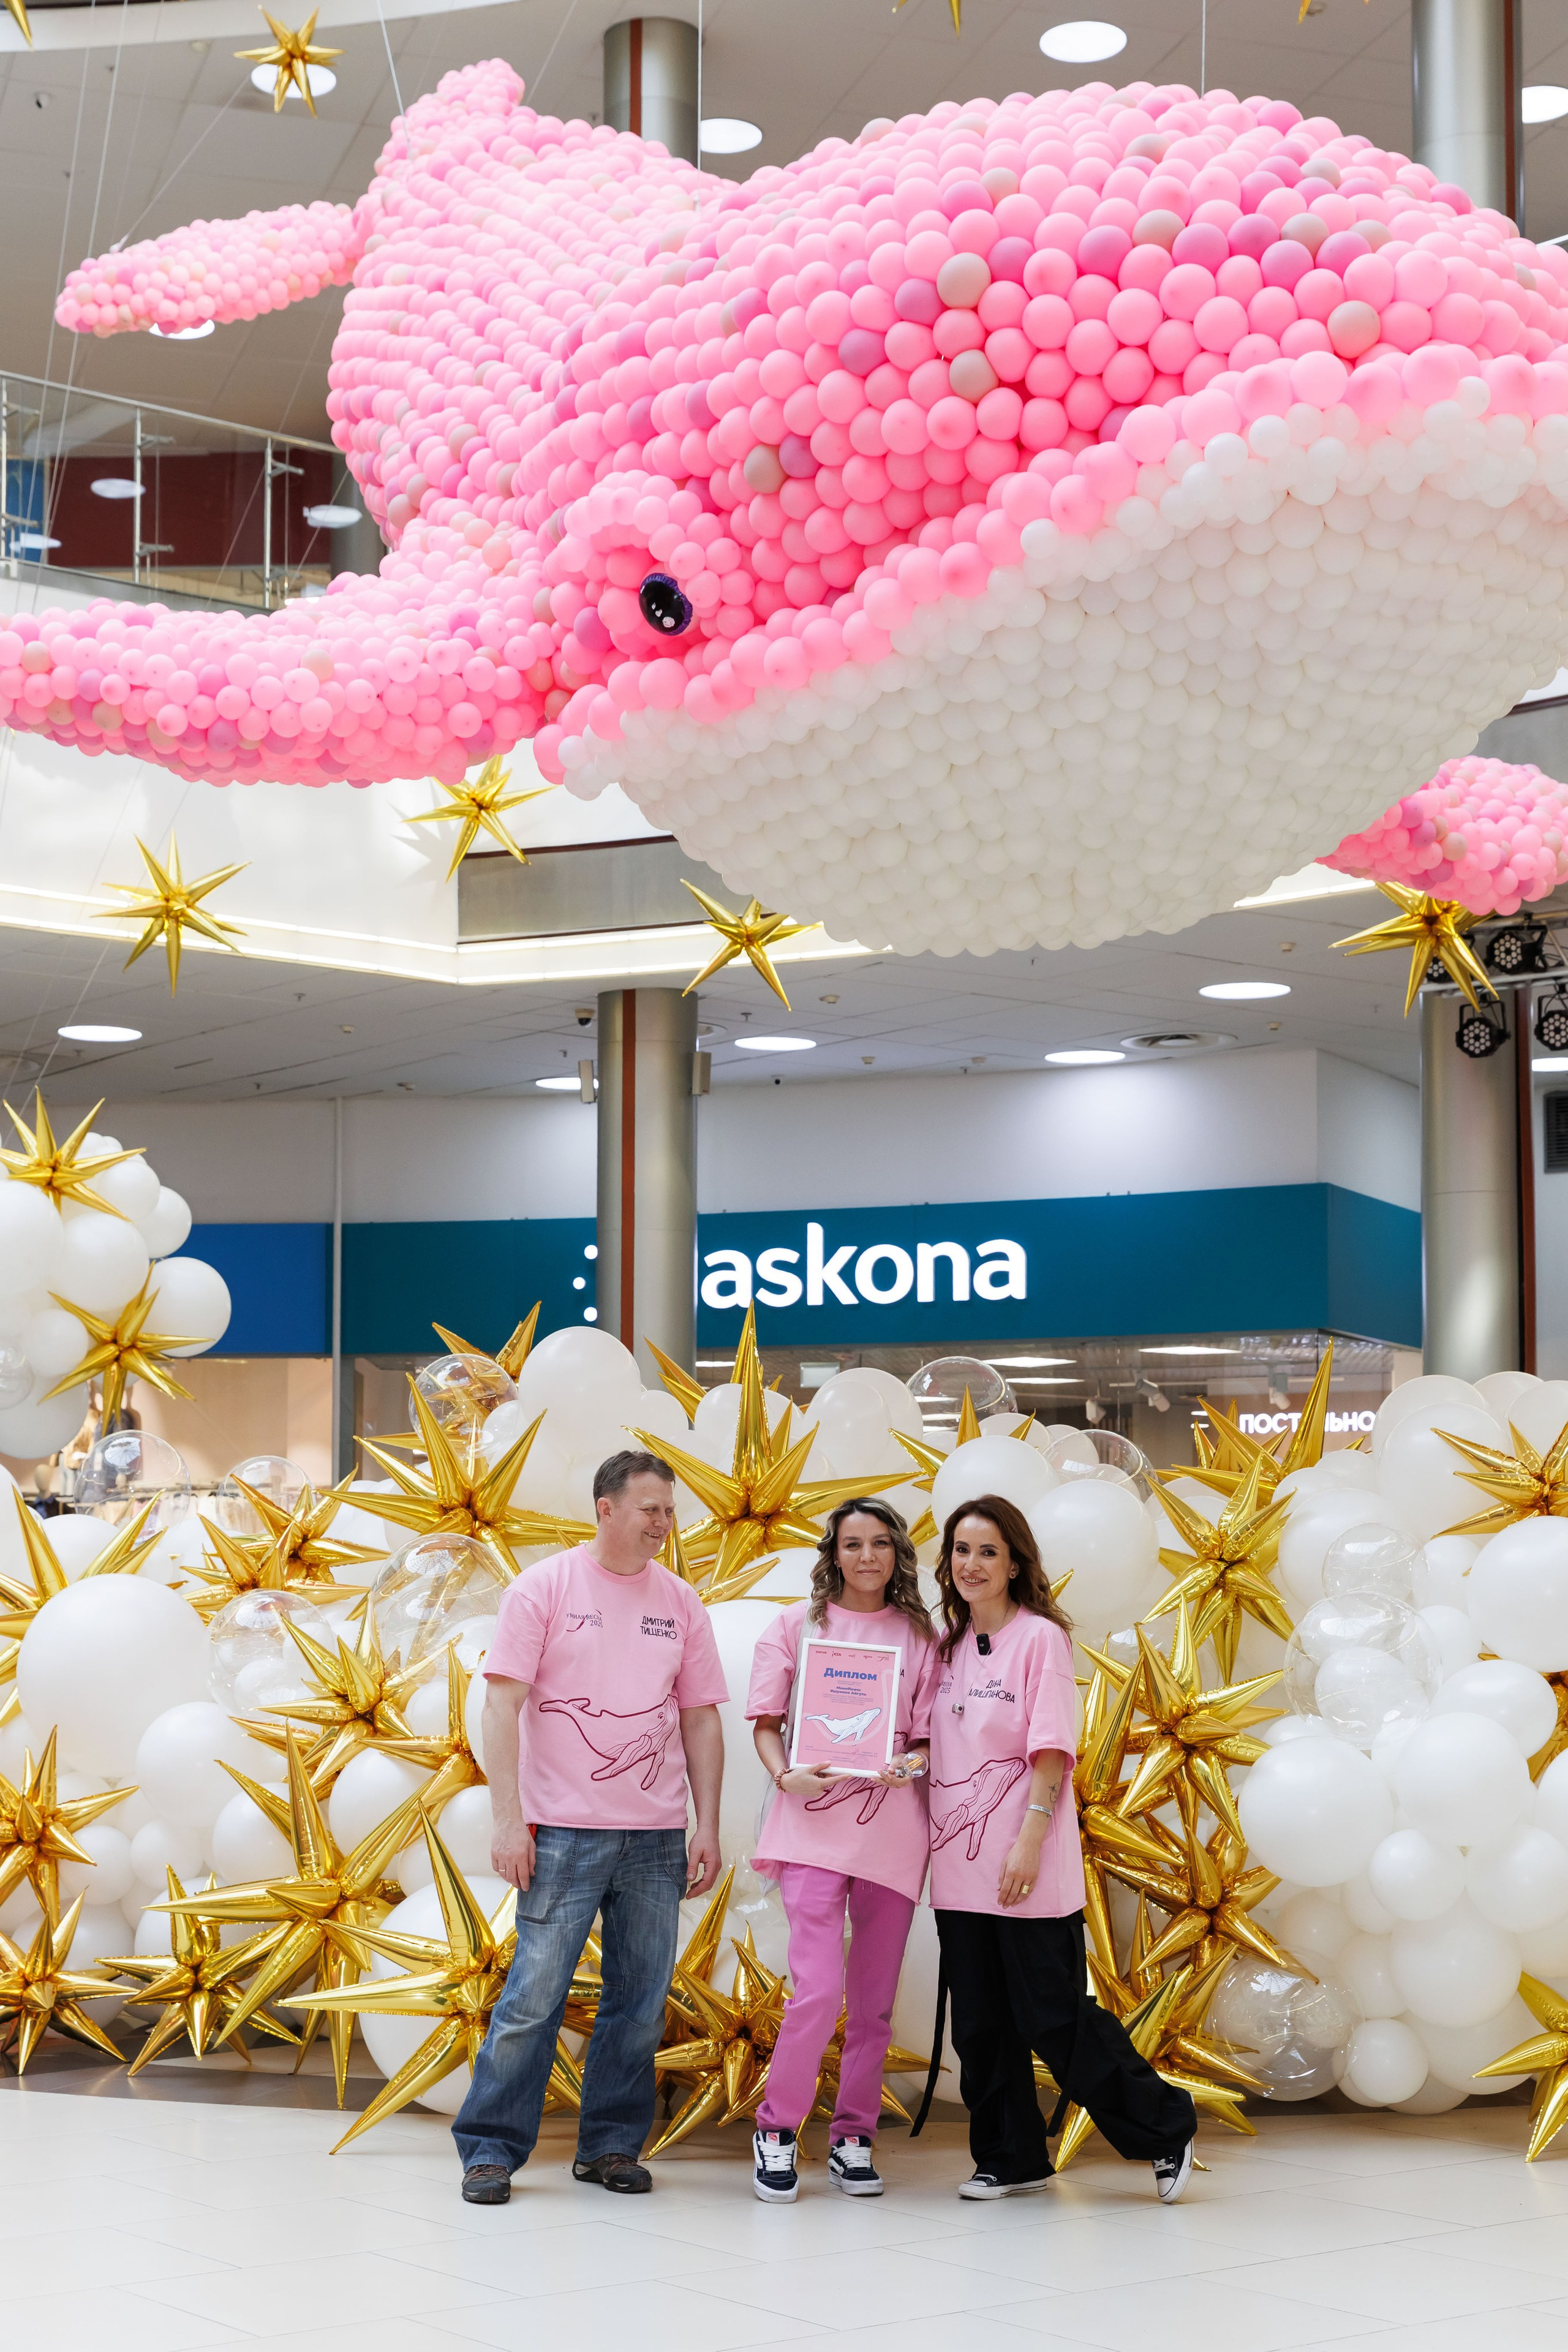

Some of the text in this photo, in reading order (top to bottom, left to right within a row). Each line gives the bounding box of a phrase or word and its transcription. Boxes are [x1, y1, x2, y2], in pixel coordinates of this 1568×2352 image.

[701, 1222, 1028, 1310] askona
[642, 1616, 675, 1628] ДМИТРИЙ
[640, 1626, 677, 1639] ТИЩЕНКО
[823, 1667, 877, 1681] Диплом
